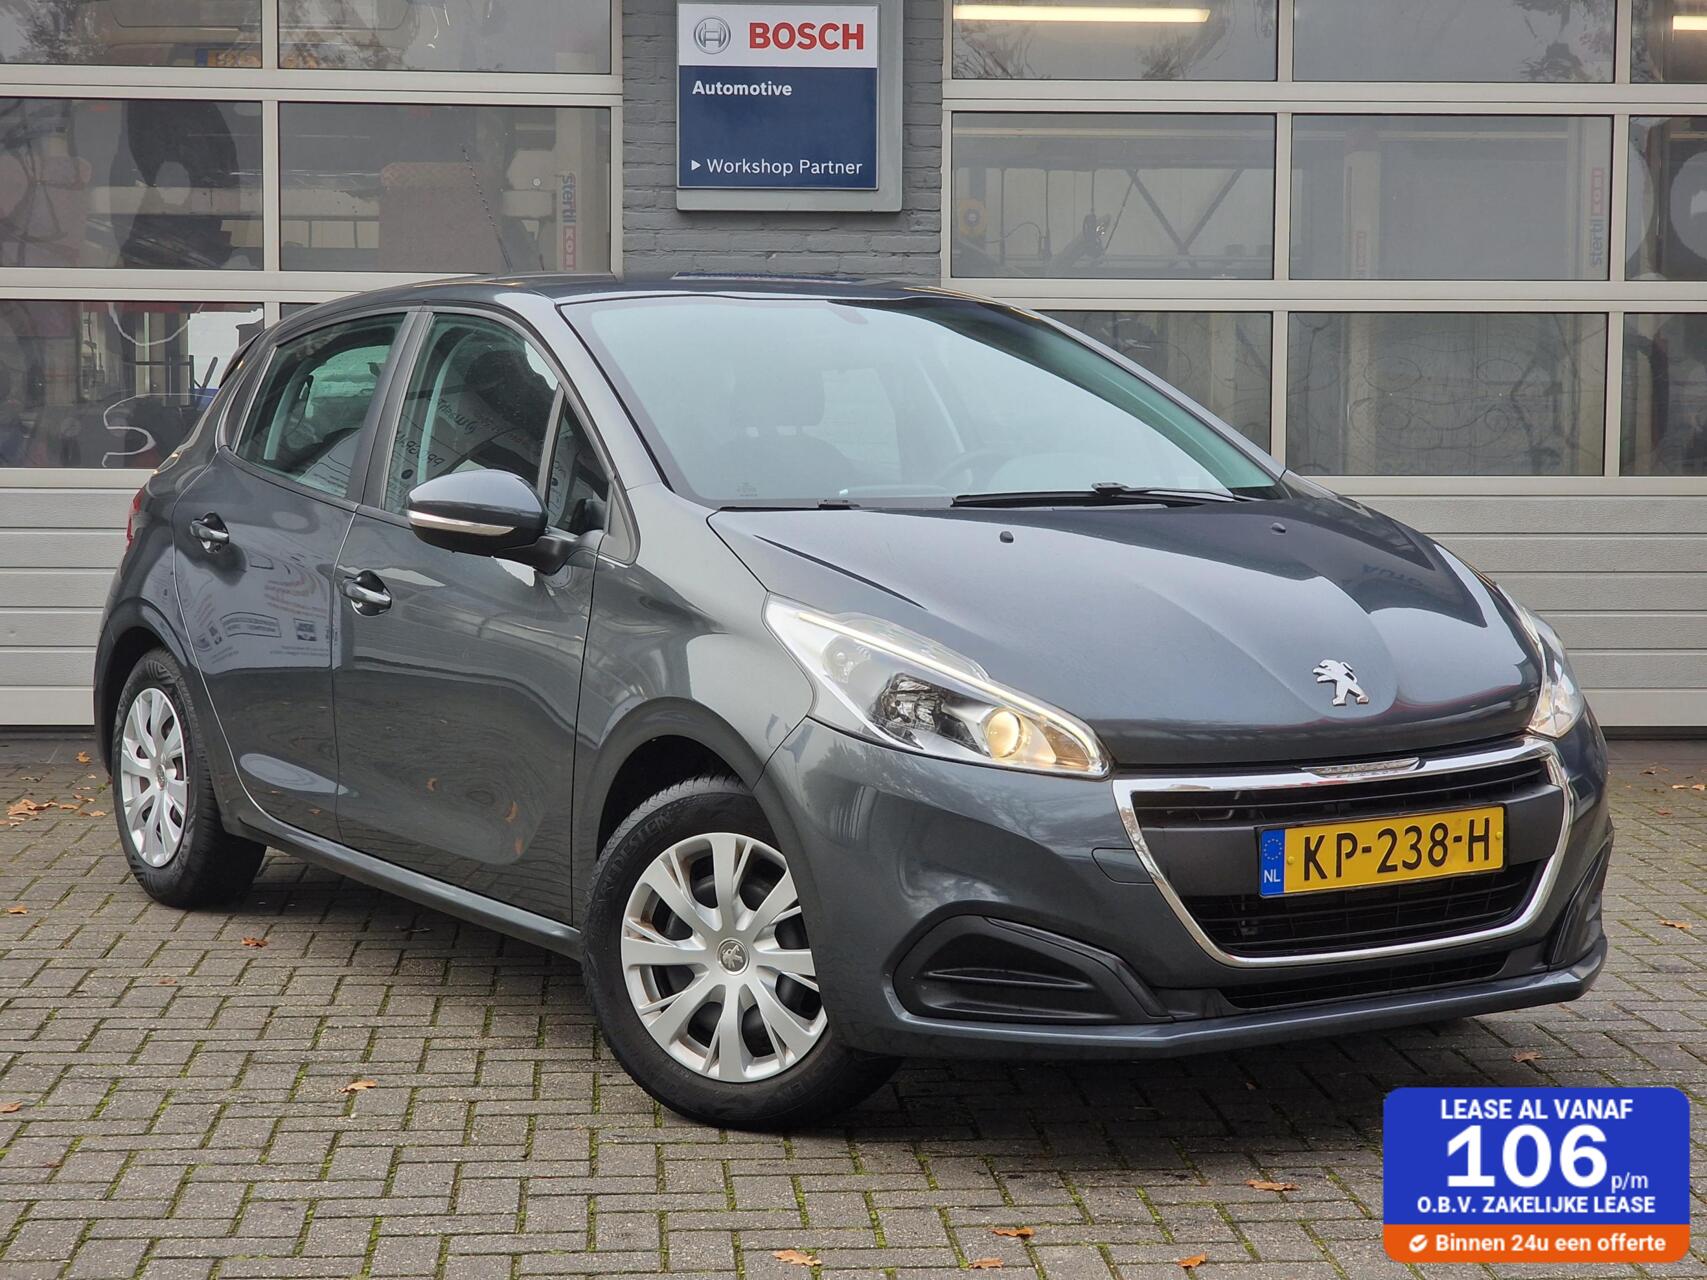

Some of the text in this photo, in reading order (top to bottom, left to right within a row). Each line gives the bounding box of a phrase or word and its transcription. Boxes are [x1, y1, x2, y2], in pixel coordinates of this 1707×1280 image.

[749, 22, 864, 51] BOSCH
[692, 80, 793, 96] Automotive
[706, 158, 863, 177] Workshop Partner
[562, 175, 577, 223] stertil
[1589, 219, 1604, 267] stertil
[1263, 817, 1490, 883] NL KP-238-H
